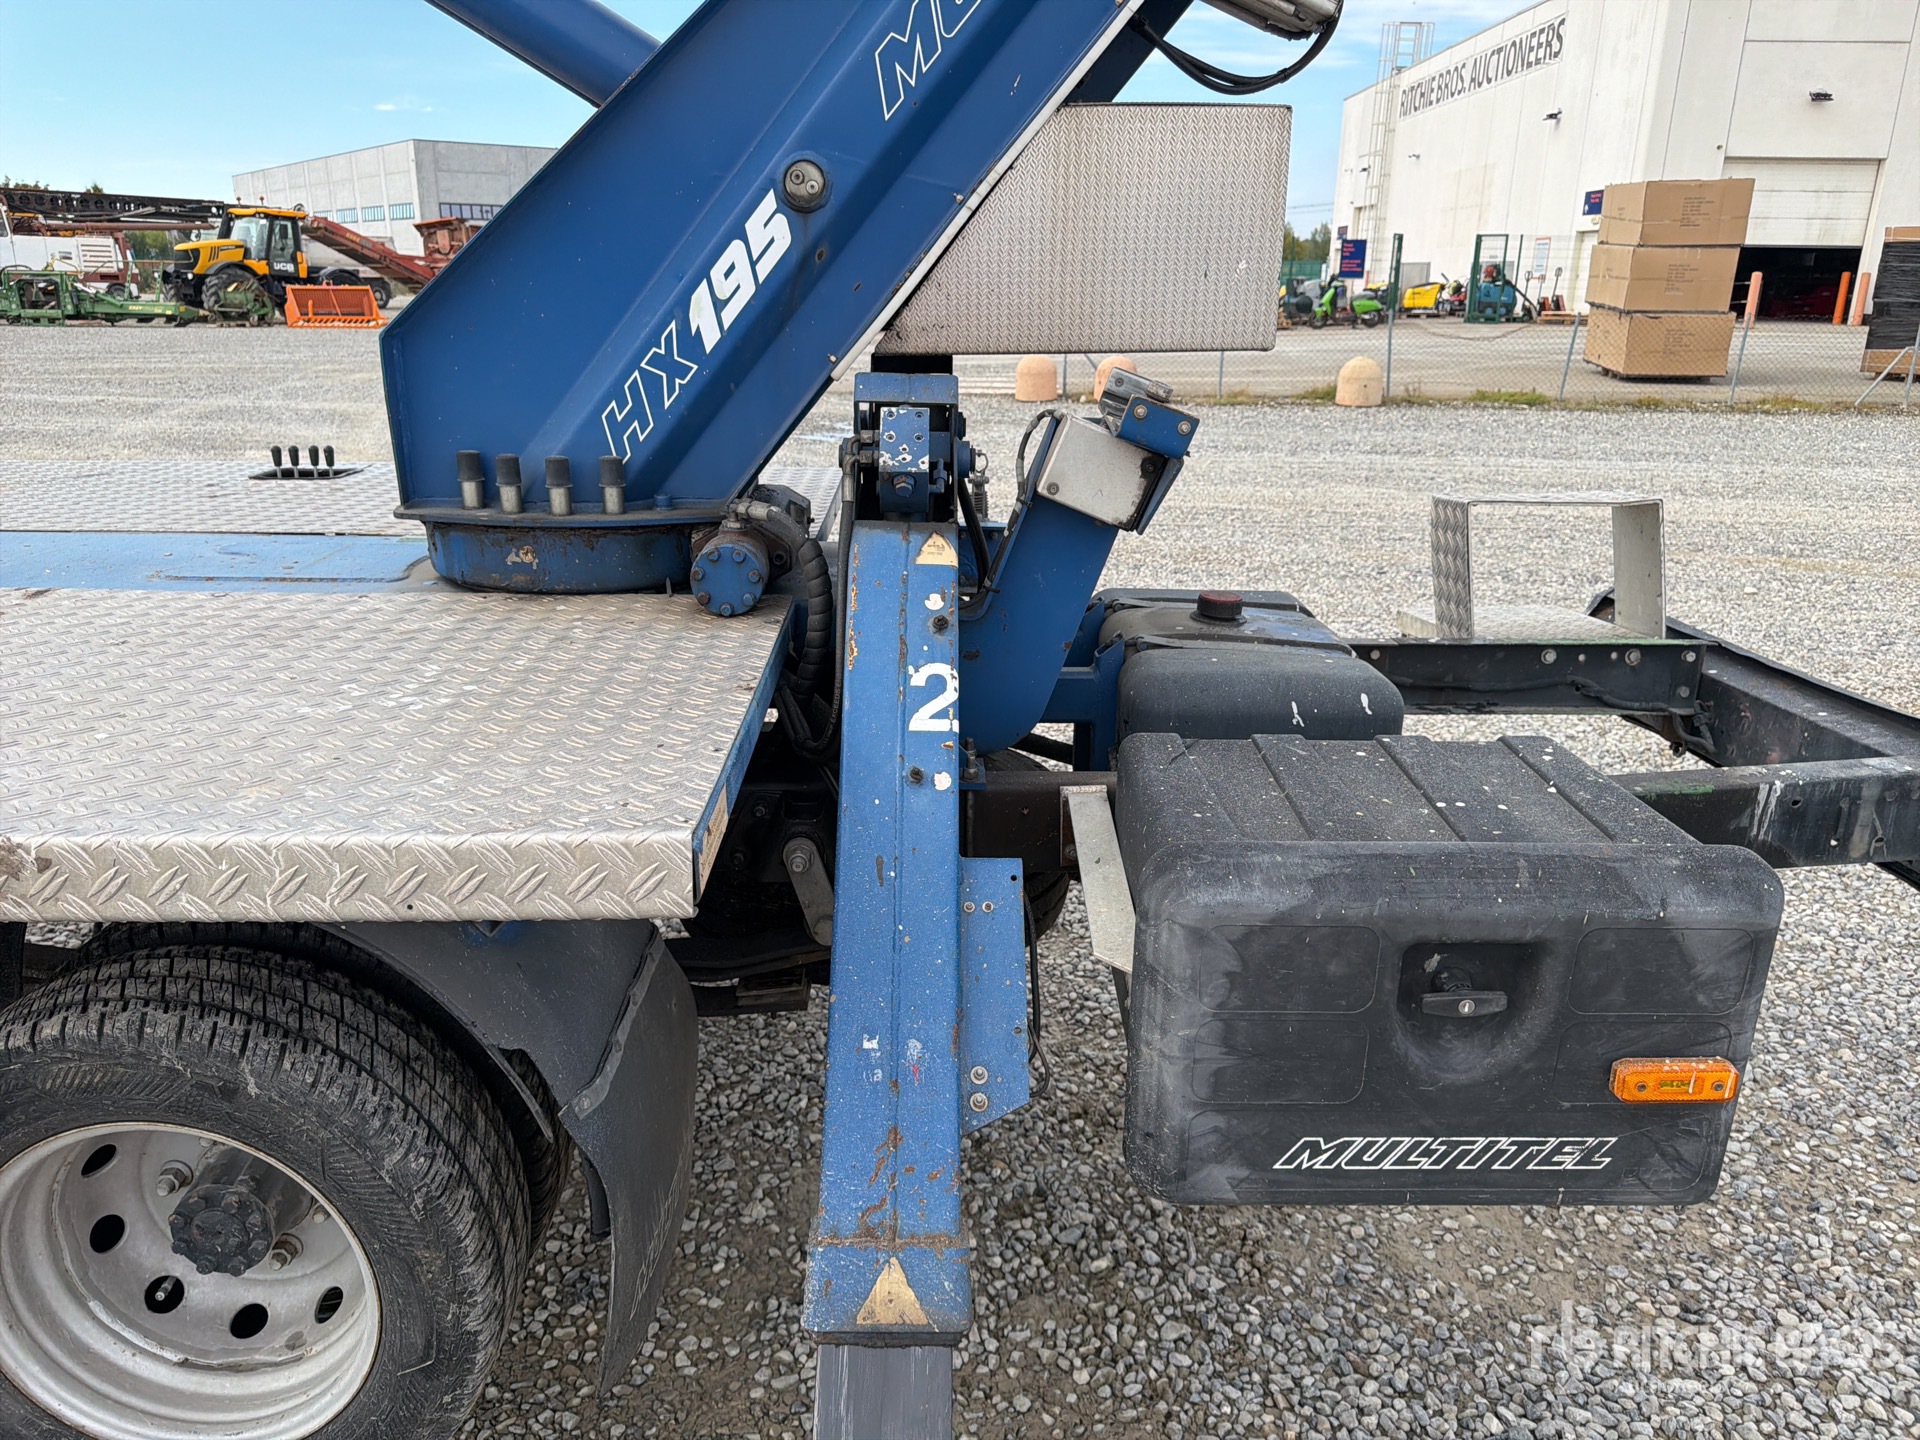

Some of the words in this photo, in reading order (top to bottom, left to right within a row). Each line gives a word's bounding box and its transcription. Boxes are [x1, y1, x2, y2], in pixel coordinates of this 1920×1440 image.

[875, 0, 981, 121] M
[1399, 75, 1436, 118] RITCHIE
[1435, 62, 1467, 105] BROS.
[1468, 17, 1567, 92] AUCTIONEERS
[601, 319, 698, 465] HX
[688, 188, 792, 355] 195
[908, 662, 959, 733] 2
[1273, 1137, 1618, 1170] MULTITEL
